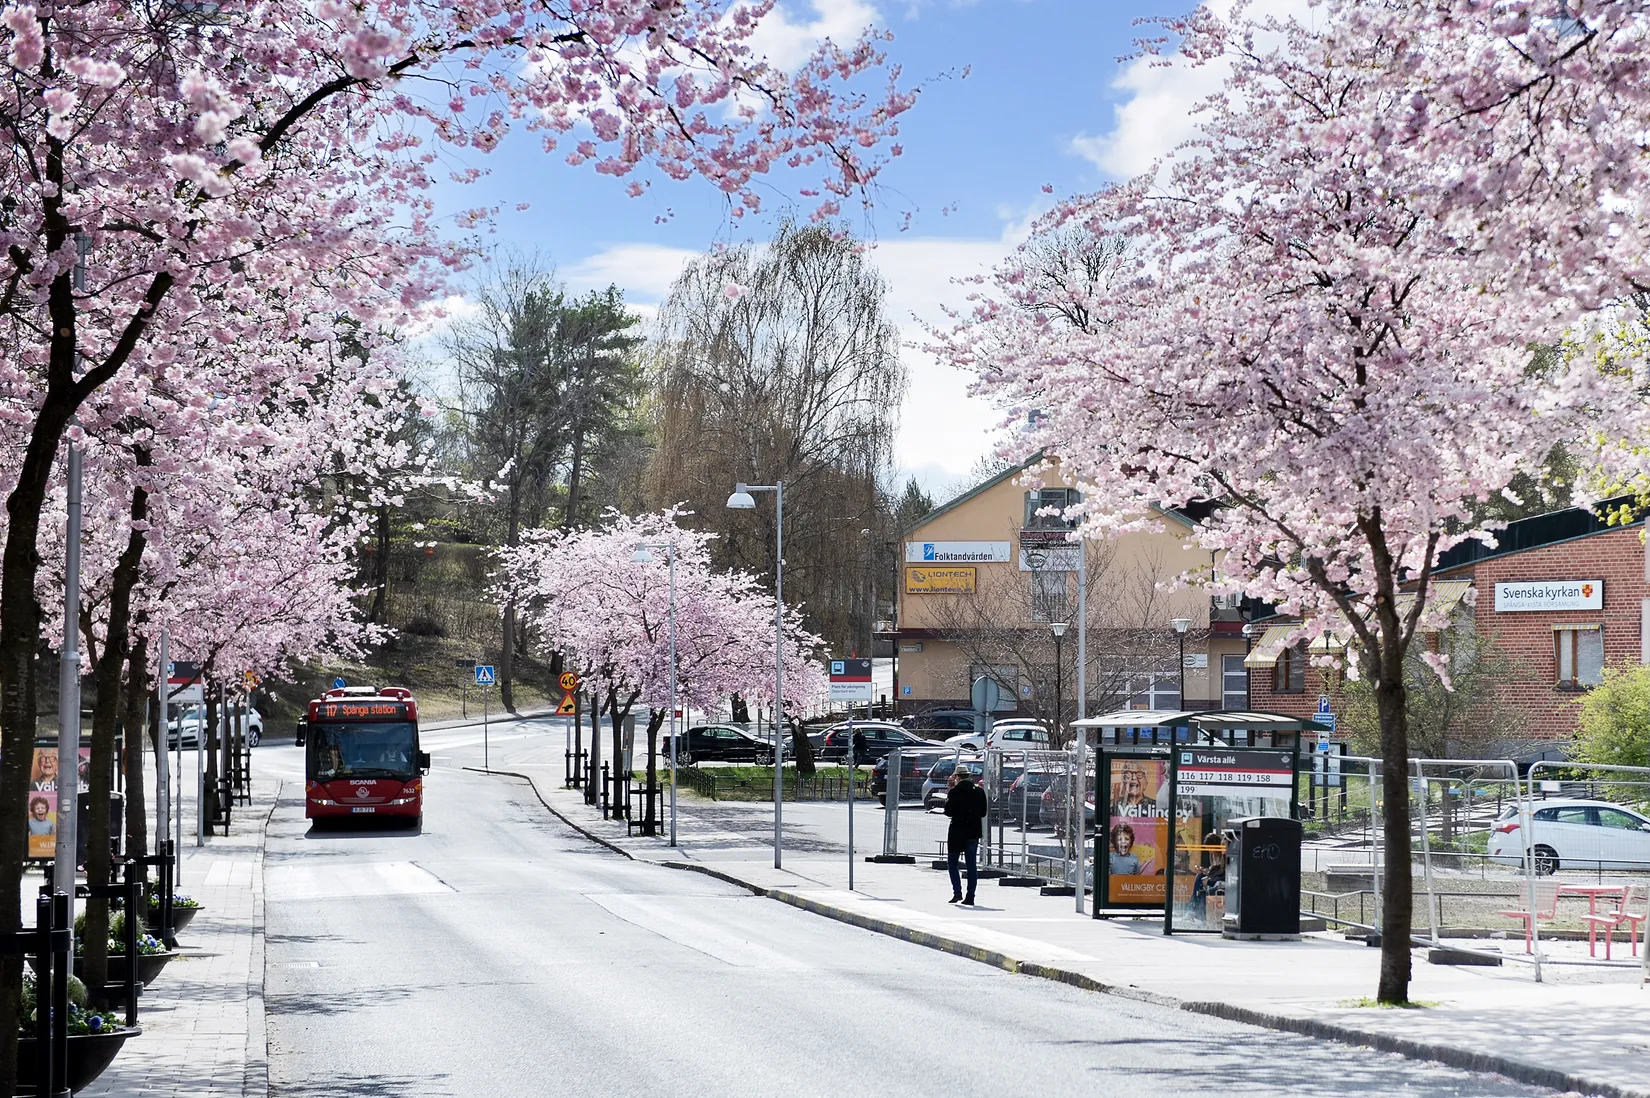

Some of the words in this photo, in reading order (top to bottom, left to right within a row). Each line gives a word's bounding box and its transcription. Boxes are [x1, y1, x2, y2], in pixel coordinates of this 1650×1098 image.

[934, 552, 993, 561] Folktandvården
[1503, 586, 1544, 599] Svenska
[1545, 586, 1580, 600] kyrkan
[562, 676, 575, 686] 40
[326, 704, 338, 716] 117
[342, 704, 369, 716] Spånga
[370, 704, 396, 714] station
[1322, 698, 1328, 712] P
[1197, 755, 1221, 764] Värsta
[1181, 772, 1196, 780] 116
[1200, 772, 1214, 780] 117
[1256, 774, 1271, 782] 158
[1181, 786, 1196, 794] 199
